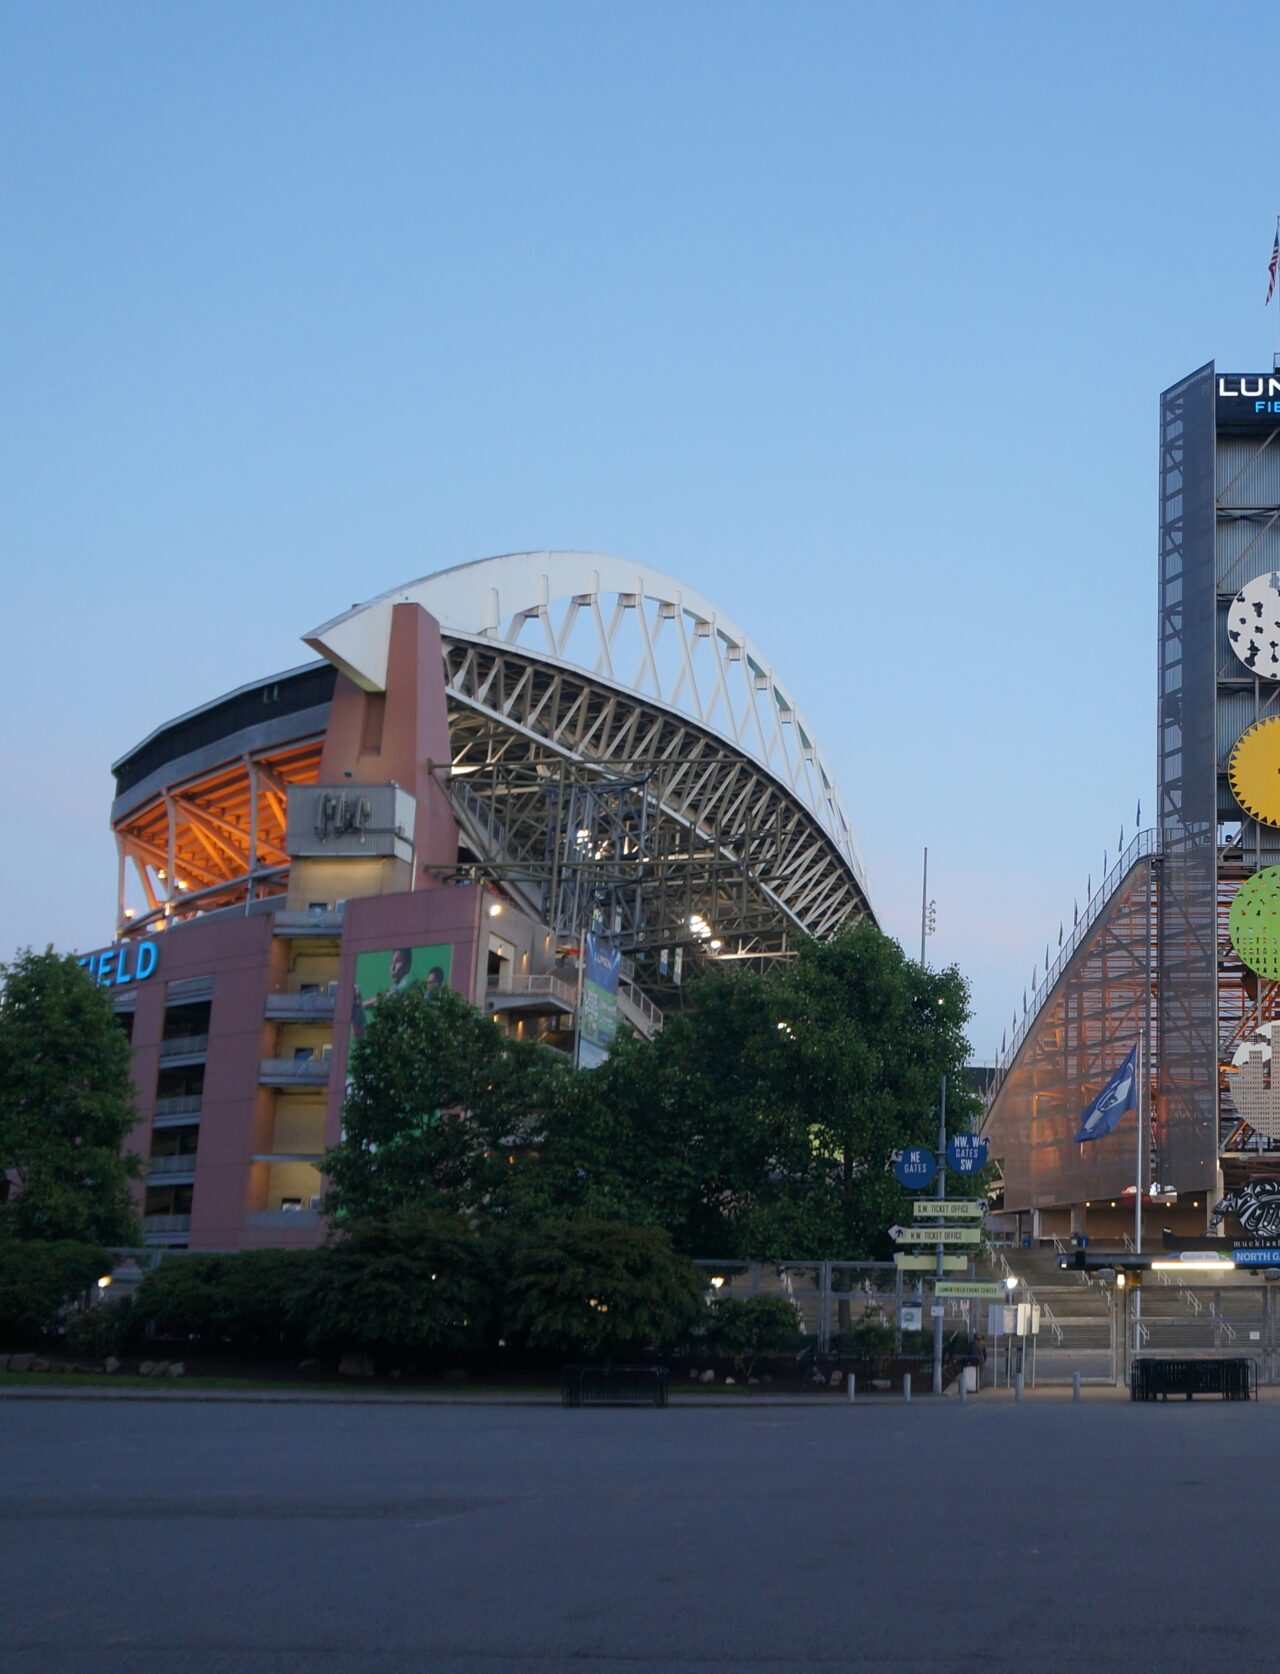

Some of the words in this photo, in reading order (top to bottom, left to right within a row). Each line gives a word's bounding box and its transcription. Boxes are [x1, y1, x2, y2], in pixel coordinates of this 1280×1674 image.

[972, 1136, 980, 1148] W
[910, 1151, 921, 1163] NE
[955, 1148, 978, 1158] GATES
[904, 1163, 927, 1173] GATES
[960, 1159, 973, 1170] SW
[931, 1204, 949, 1213] TICKET
[950, 1204, 969, 1213] OFFICE
[925, 1231, 943, 1240] TICKET
[944, 1231, 962, 1240] OFFICE
[1236, 1252, 1271, 1261] NORTH
